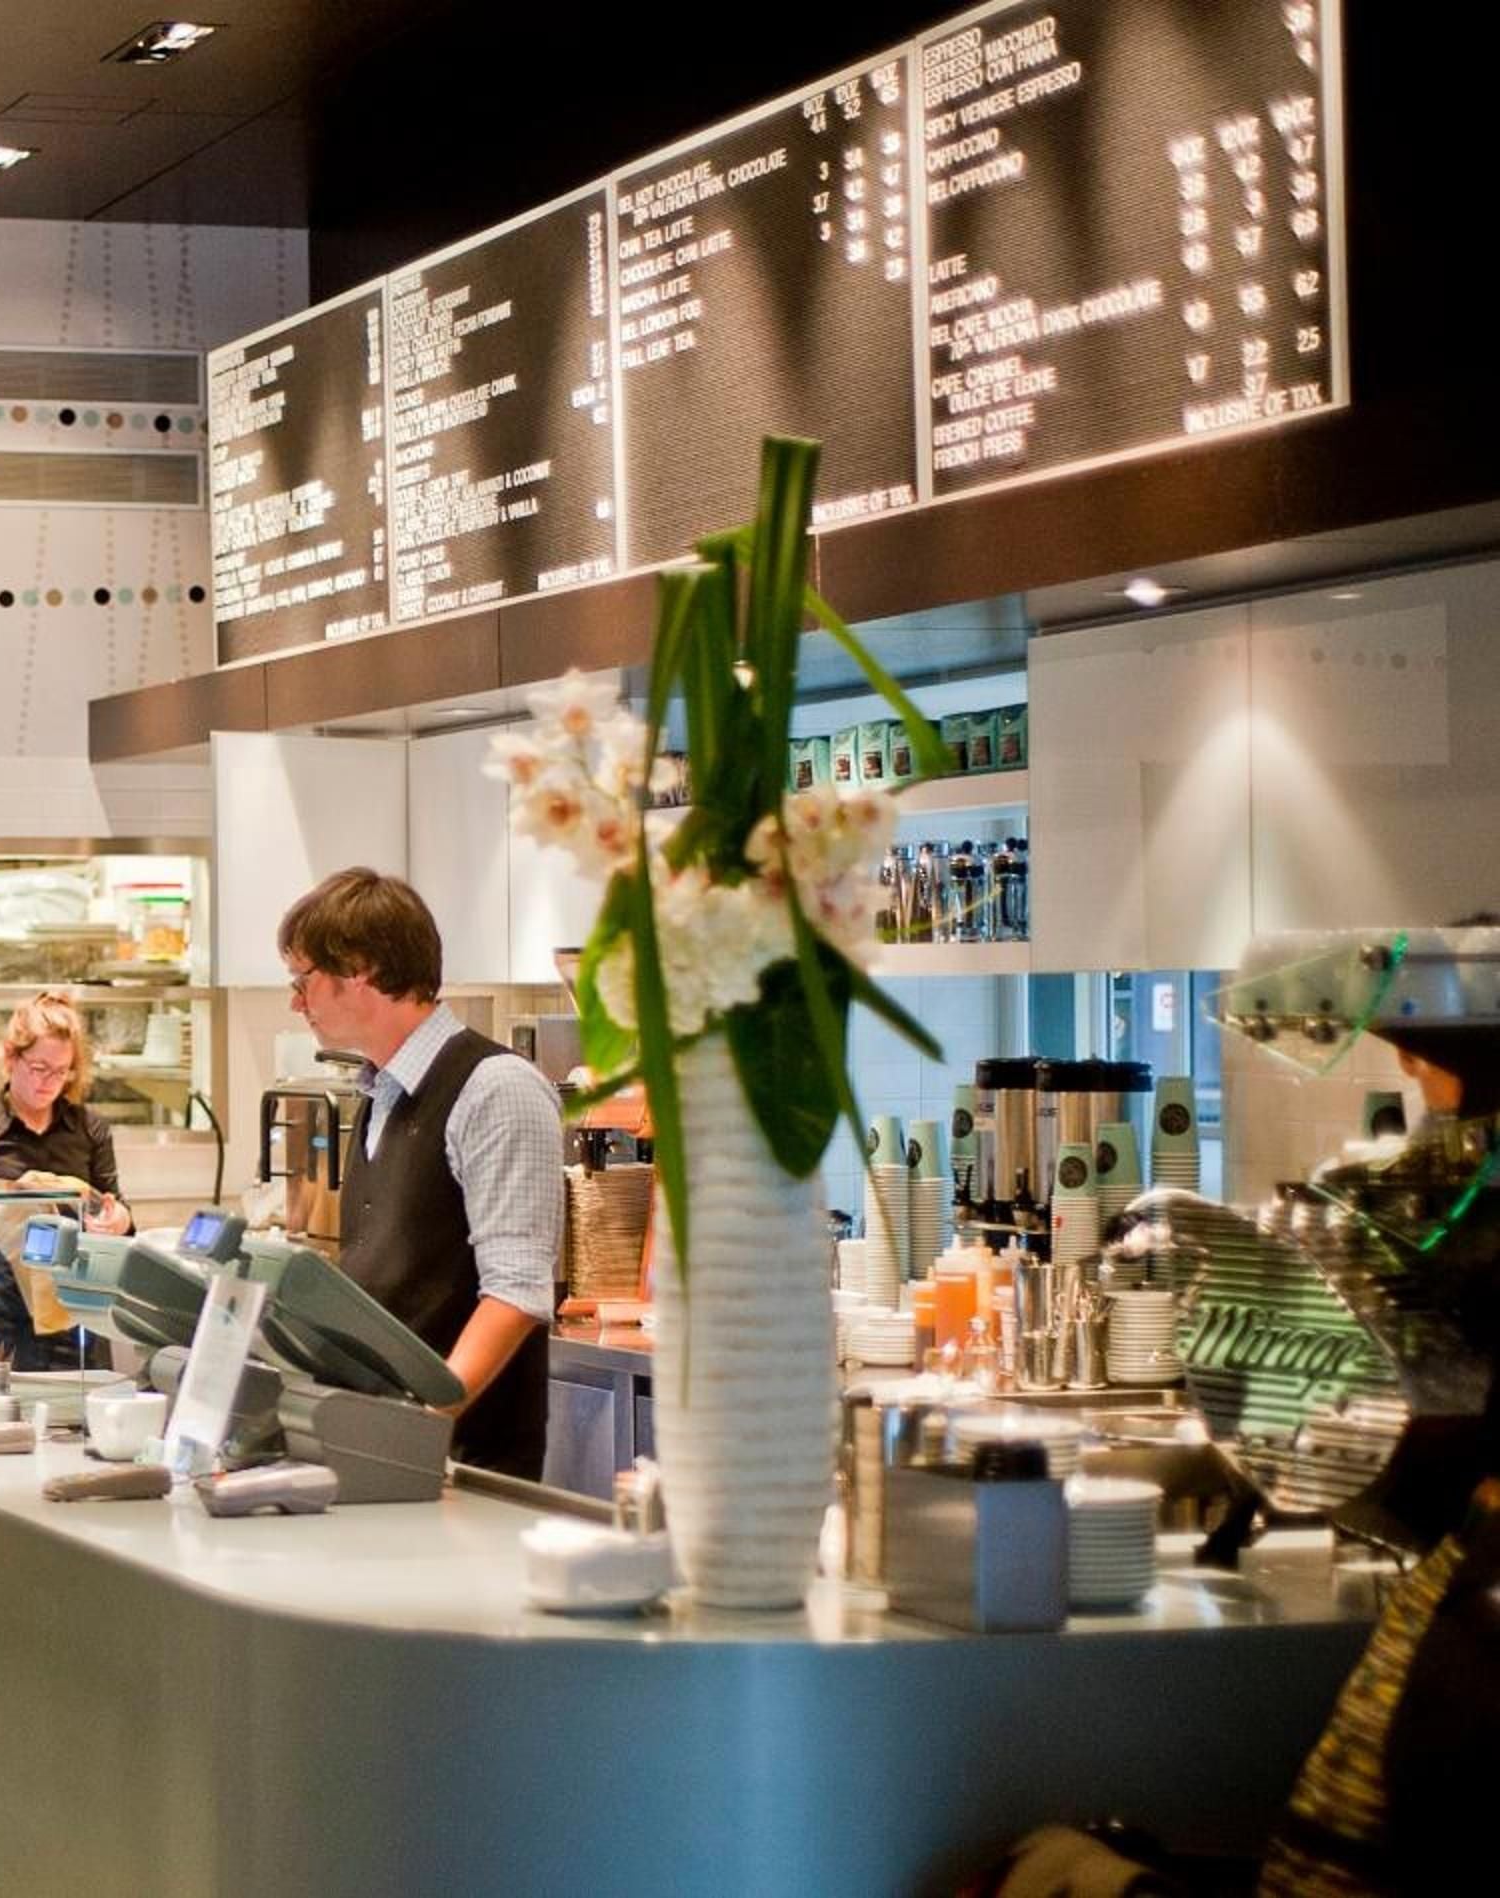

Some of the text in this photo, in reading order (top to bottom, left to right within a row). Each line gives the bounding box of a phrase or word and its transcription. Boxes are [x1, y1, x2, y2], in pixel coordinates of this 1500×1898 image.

[923, 26, 981, 68] ESPRESSO
[924, 47, 981, 88] ESPRESSO
[925, 67, 982, 108] ESPRESSO
[987, 55, 1013, 83] CON
[1017, 60, 1080, 104] ESPRESSO
[844, 97, 860, 121] 52
[656, 159, 710, 200] CHOCOLATE
[727, 146, 786, 189] CHOCOLATE
[819, 159, 828, 182] 3
[644, 227, 662, 250] TEA
[665, 214, 693, 242] LATTE
[620, 251, 672, 288] CHOCOLATE
[700, 228, 731, 257] LATTE
[929, 253, 966, 283] LATTE
[661, 273, 690, 301] LATTE
[1296, 323, 1320, 353] 25
[1266, 387, 1288, 415] OF
[1291, 380, 1321, 409] TAX
[1184, 1304, 1372, 1398] Mirage
